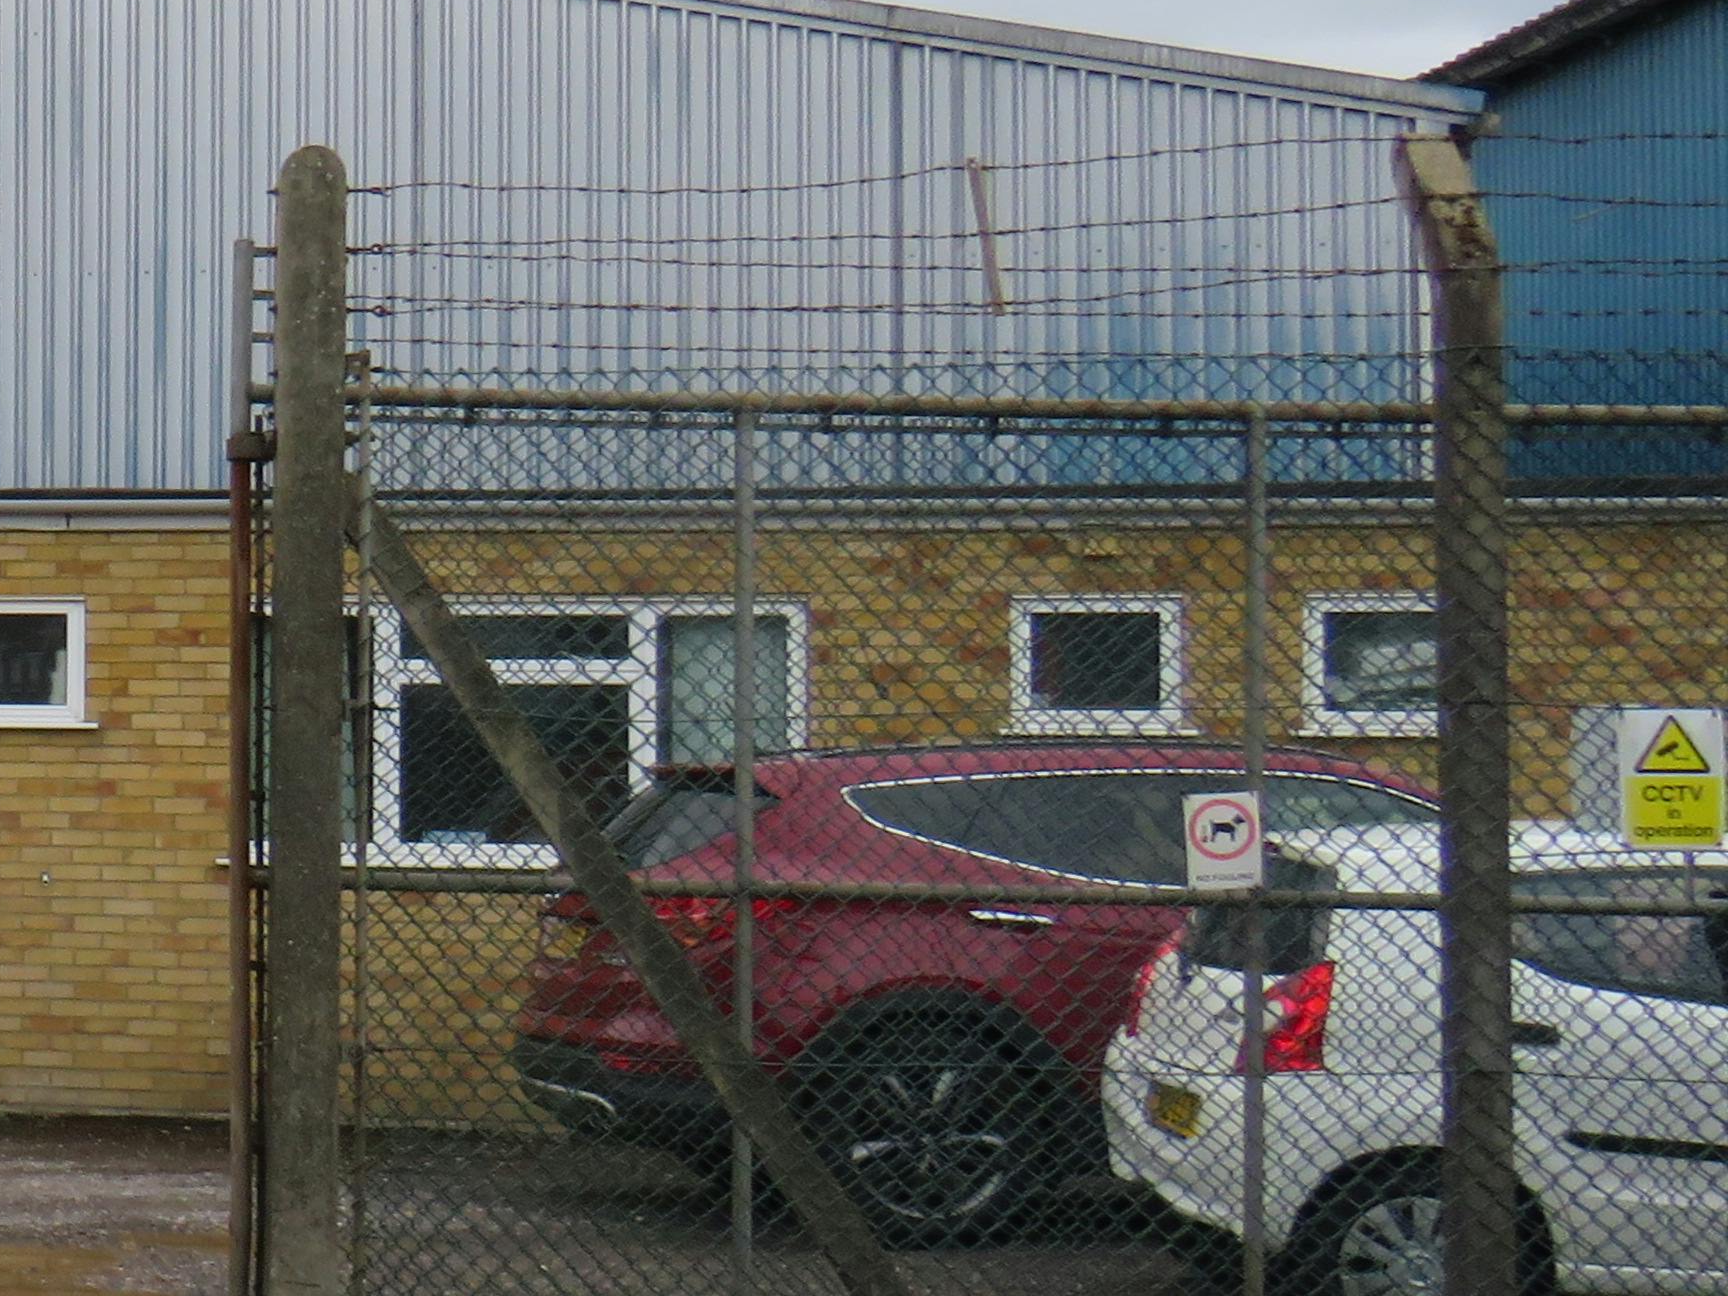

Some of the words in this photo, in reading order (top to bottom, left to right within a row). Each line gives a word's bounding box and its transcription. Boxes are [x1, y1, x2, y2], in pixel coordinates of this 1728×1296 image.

[1641, 785, 1704, 802] CCTV
[1667, 809, 1682, 819] in
[1635, 825, 1714, 840] operation
